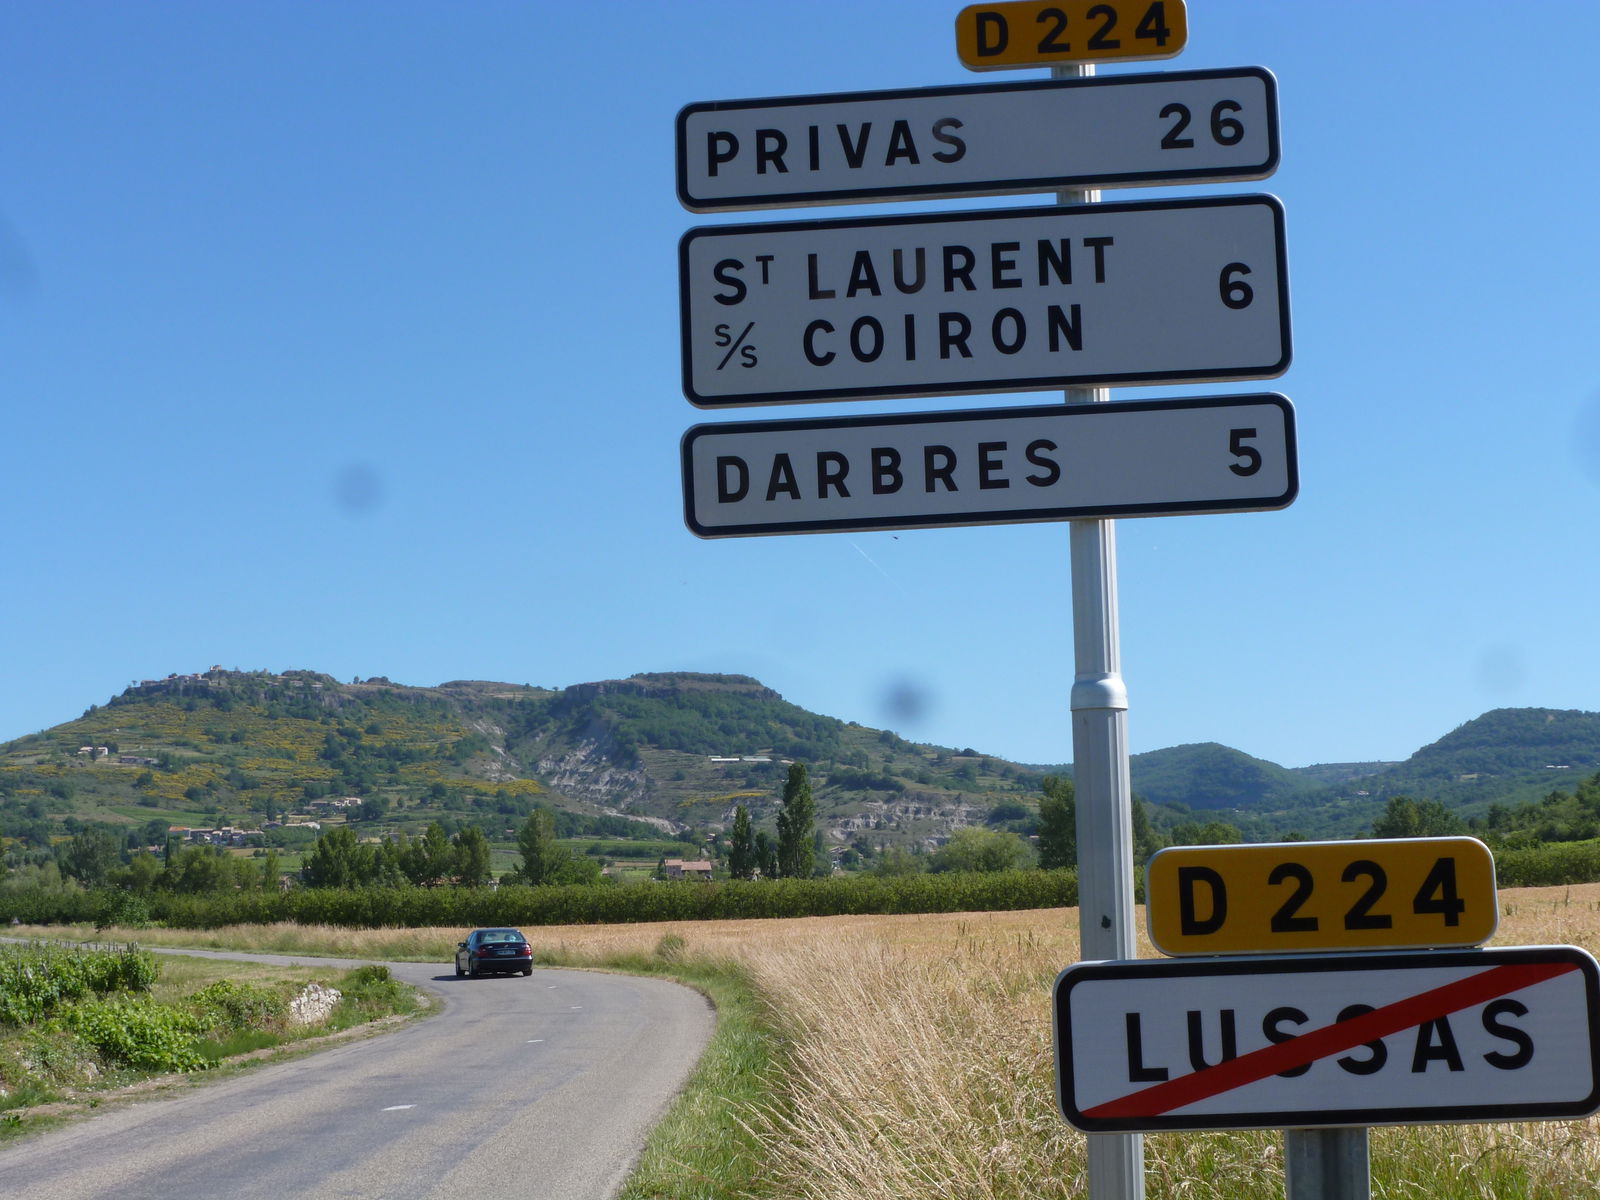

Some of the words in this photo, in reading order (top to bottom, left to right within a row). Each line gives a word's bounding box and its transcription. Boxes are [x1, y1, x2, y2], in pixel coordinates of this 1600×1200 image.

[975, 11, 1010, 57] D
[1035, 1, 1171, 54] 224
[707, 117, 967, 177] PRIVAS
[1158, 99, 1245, 151] 26
[808, 236, 1114, 301] LAURENT
[1219, 262, 1254, 310] 6
[803, 303, 1084, 367] COIRON
[716, 438, 1061, 504] DARBRES
[1228, 428, 1262, 477] 5
[1178, 866, 1227, 936] D
[1267, 857, 1465, 933] 224
[1125, 998, 1534, 1083] LUSSAS
